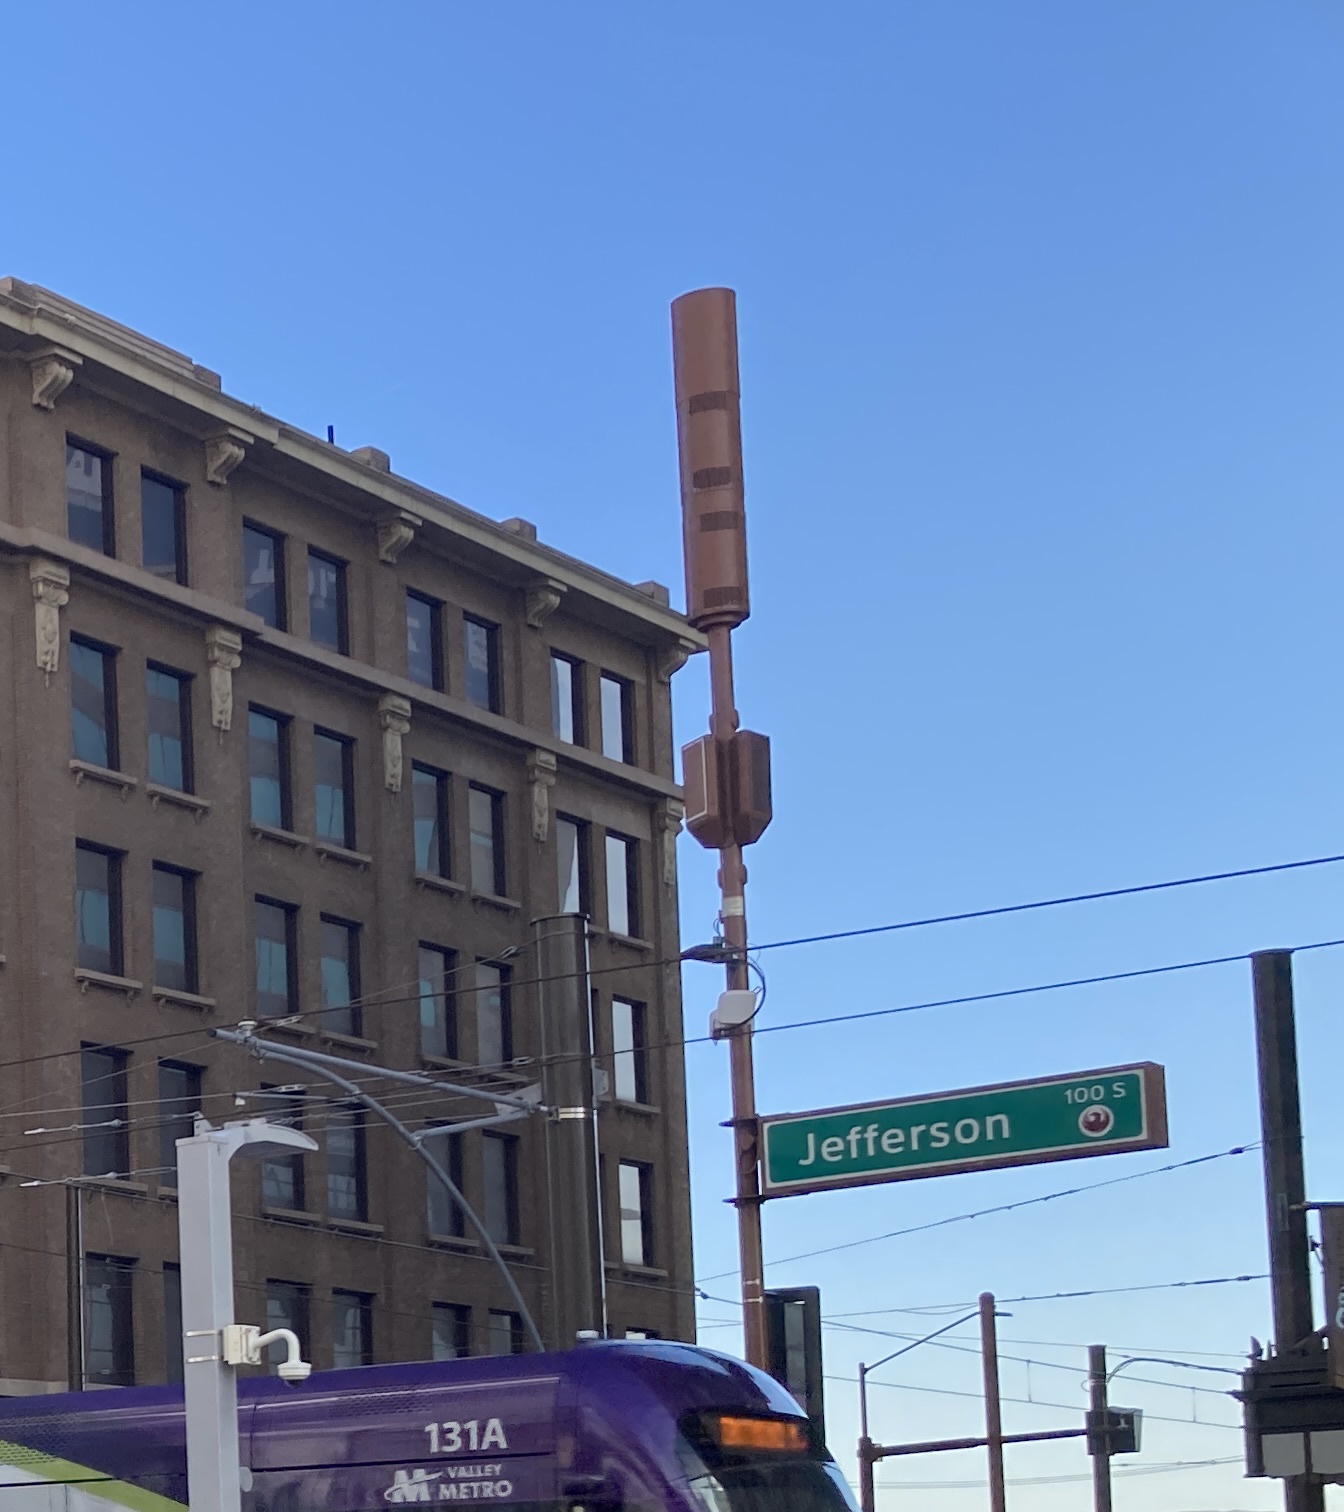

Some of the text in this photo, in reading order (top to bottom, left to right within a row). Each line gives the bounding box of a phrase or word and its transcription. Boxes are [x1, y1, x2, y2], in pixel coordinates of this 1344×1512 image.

[1064, 1081, 1127, 1105] 100 S
[798, 1112, 1011, 1167] Jefferson
[424, 1417, 509, 1454] 131A
[446, 1463, 502, 1479] VALLEY
[438, 1480, 513, 1501] METRO
